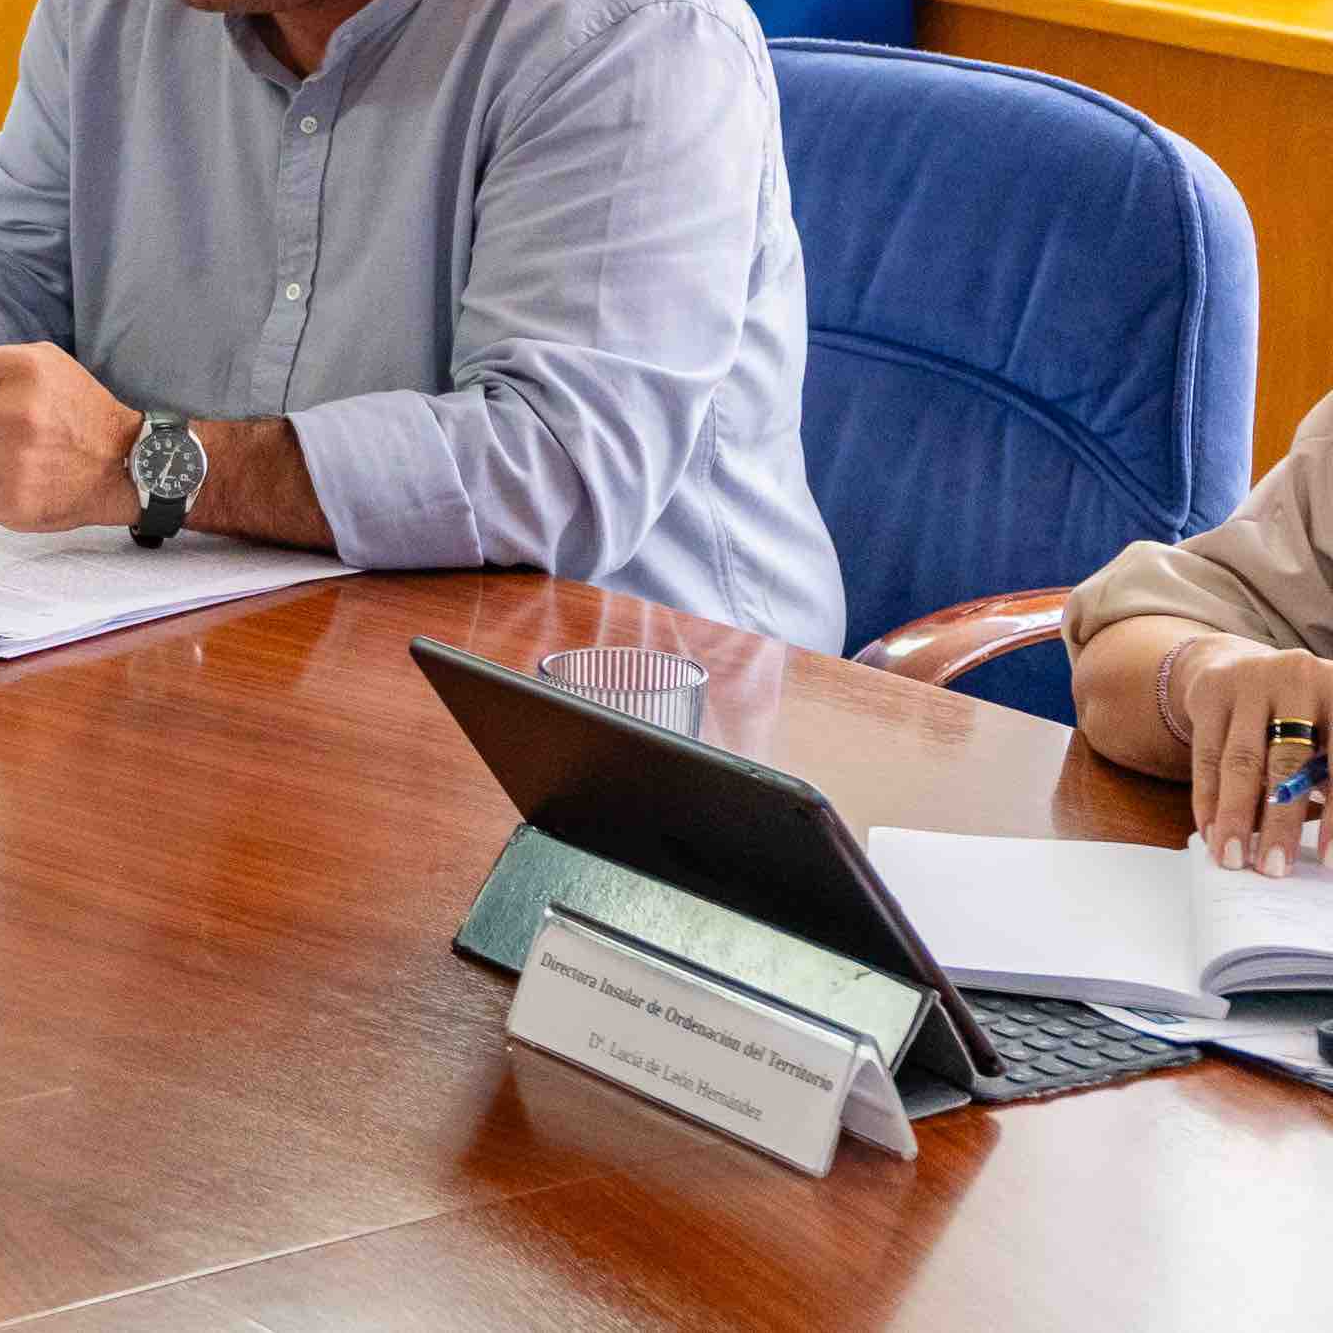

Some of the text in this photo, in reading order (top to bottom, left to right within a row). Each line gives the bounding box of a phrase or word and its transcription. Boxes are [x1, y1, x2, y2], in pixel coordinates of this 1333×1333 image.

[540, 951, 834, 1093] Directora Insular de Ordenación del Territorio
[645, 1057, 661, 1075] de
